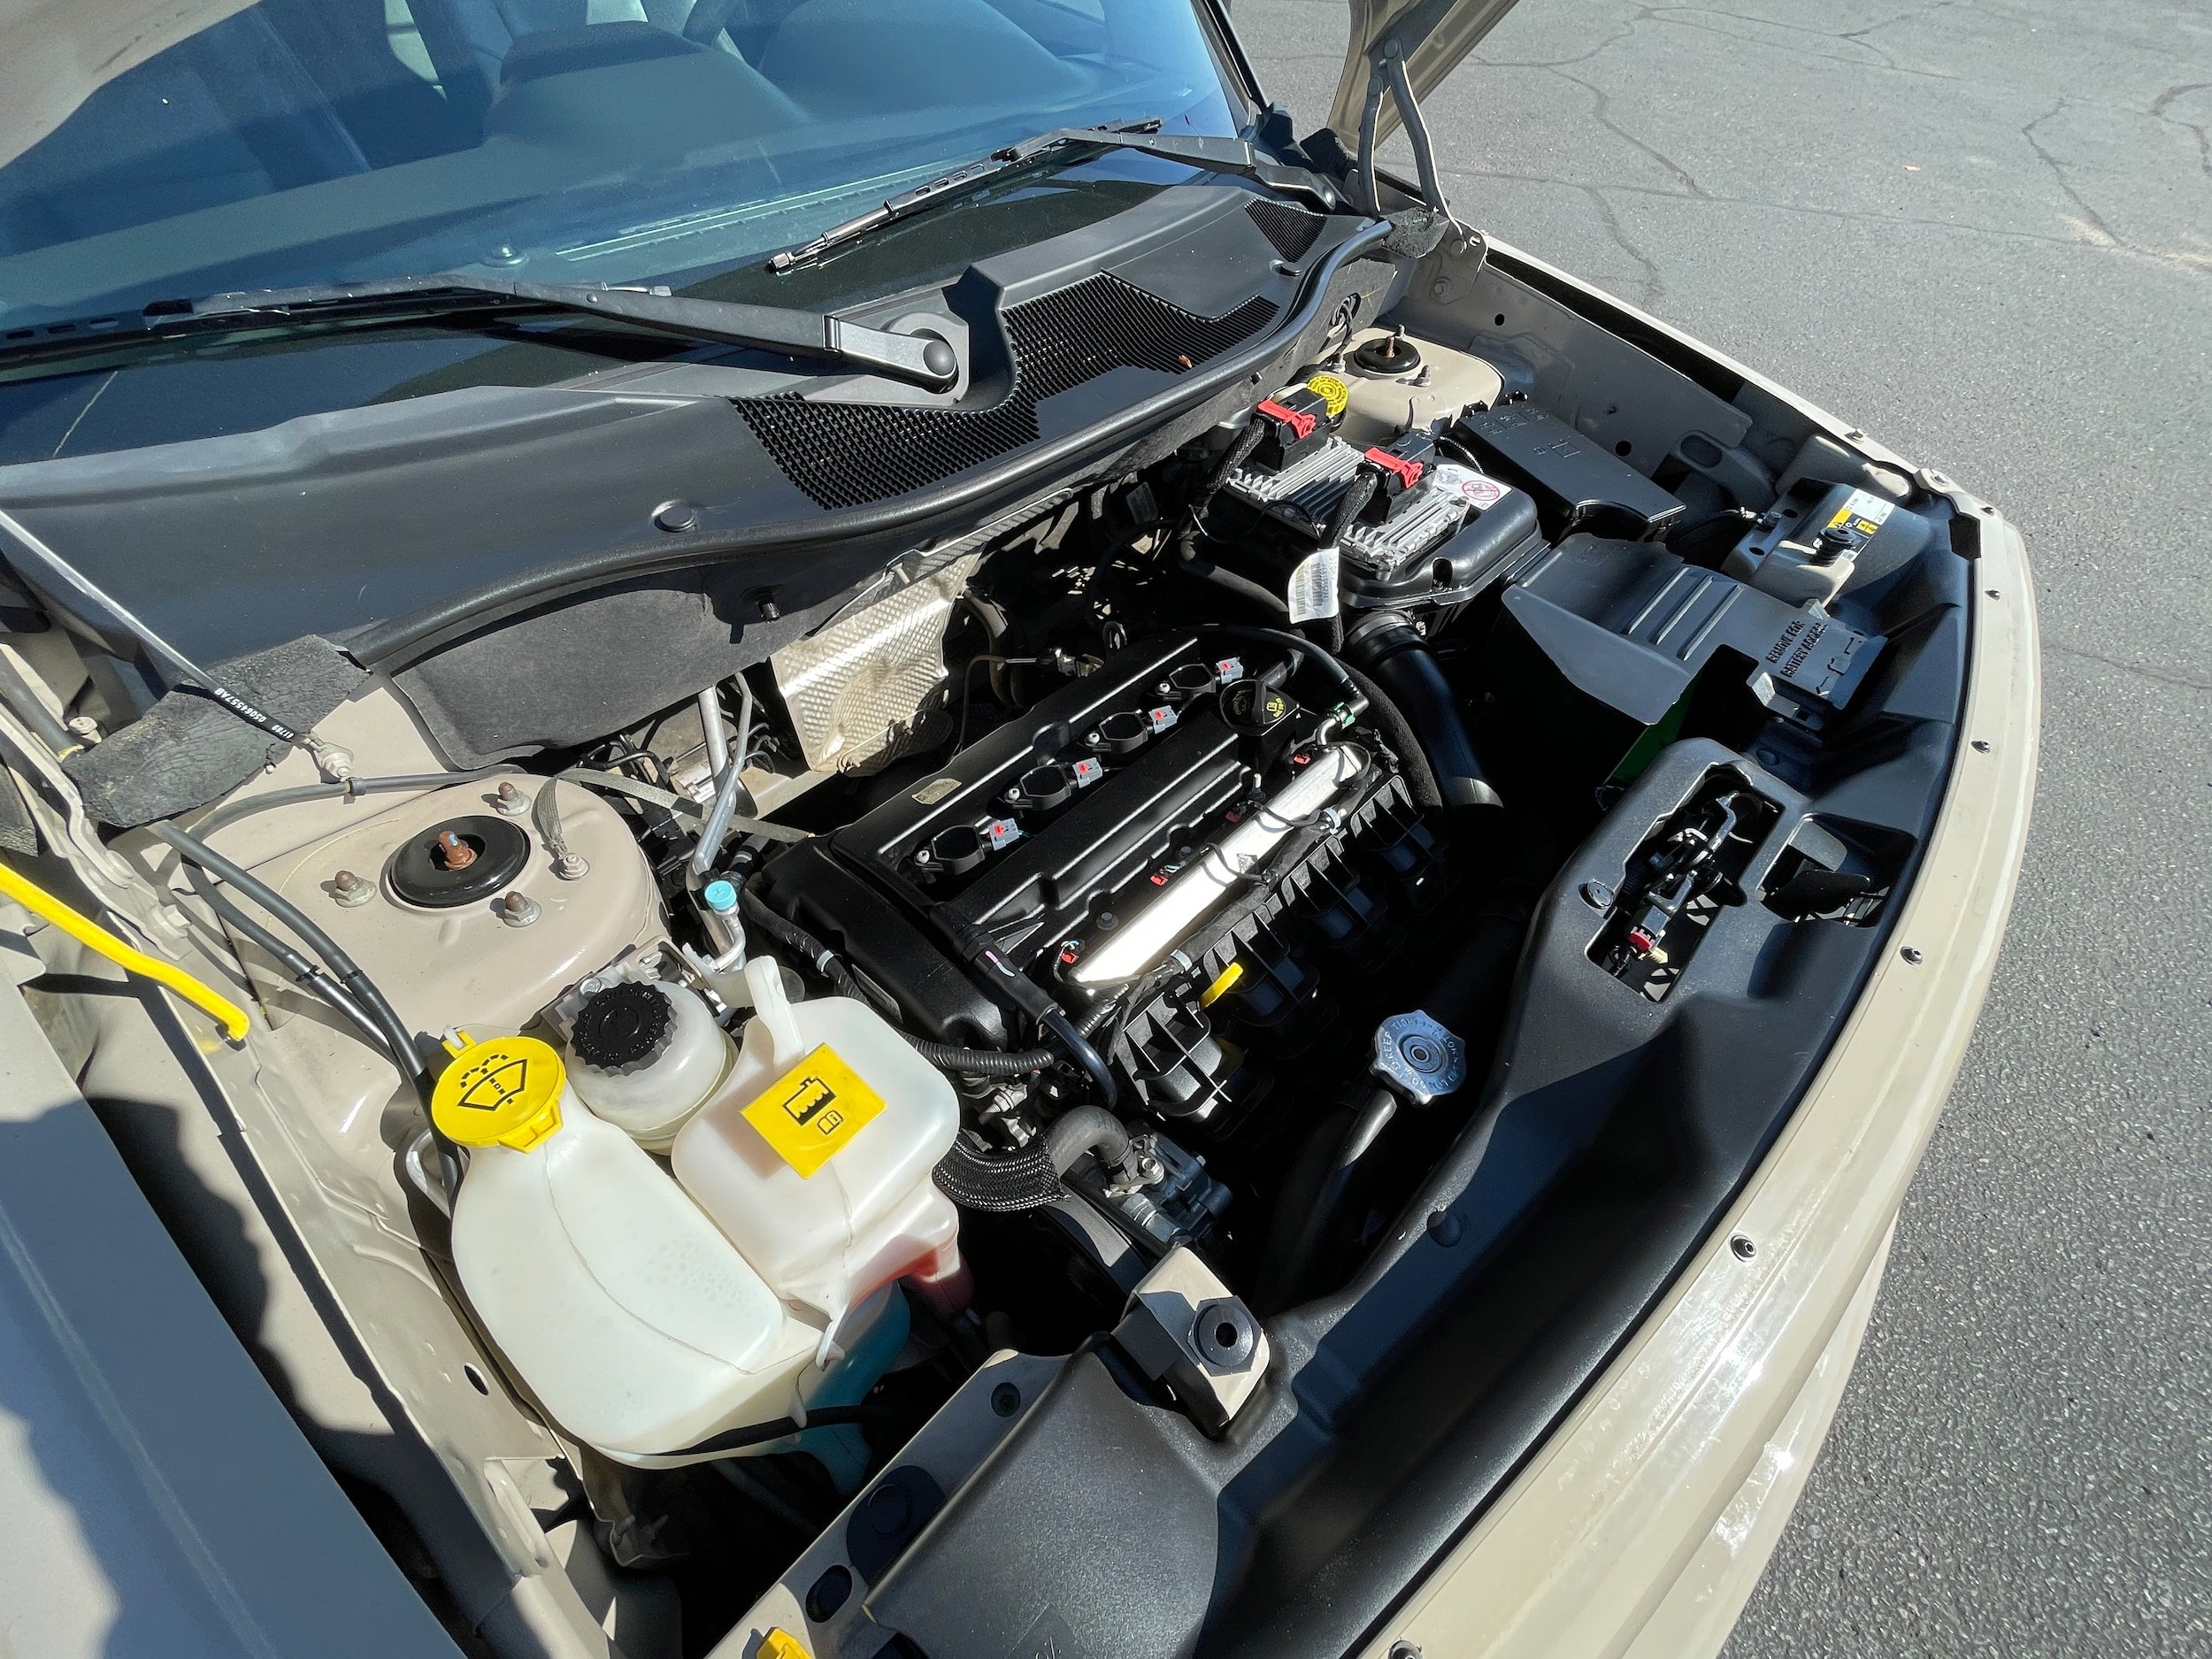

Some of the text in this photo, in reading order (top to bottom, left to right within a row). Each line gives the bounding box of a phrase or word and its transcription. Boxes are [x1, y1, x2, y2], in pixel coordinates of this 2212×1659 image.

[1765, 620, 1806, 664] REMOVE FOR
[1779, 622, 1828, 678] BATTERY ACCESS
[1383, 1031, 1393, 1060] KEEP
